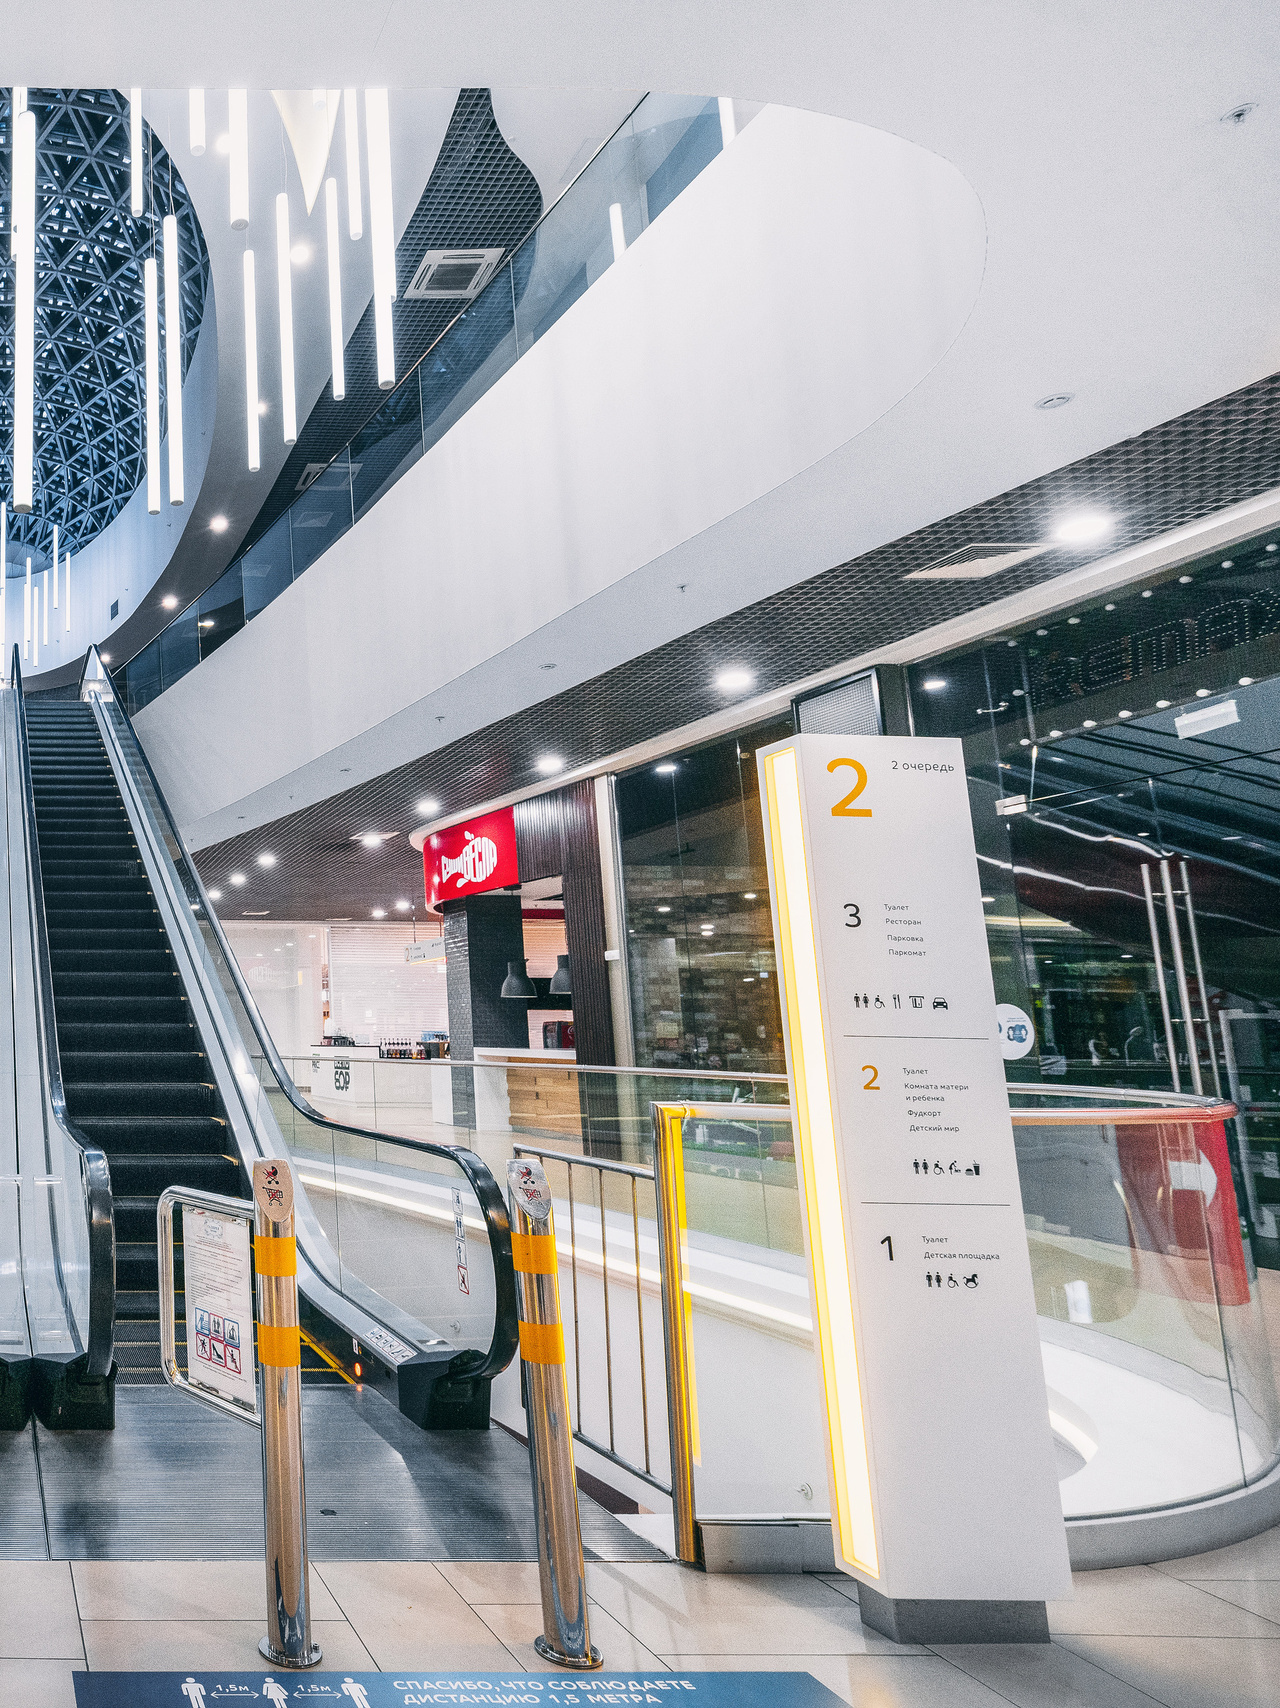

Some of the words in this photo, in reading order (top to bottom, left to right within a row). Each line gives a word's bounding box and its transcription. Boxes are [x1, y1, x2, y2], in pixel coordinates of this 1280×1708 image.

[891, 760, 899, 771] 2
[902, 761, 955, 773] очередь
[826, 757, 873, 818] 2
[883, 903, 909, 912] Туалет
[843, 903, 862, 928] 3
[885, 917, 922, 927] Ресторан
[887, 934, 924, 943] Парковка
[888, 948, 927, 957] Паркомат
[902, 1067, 928, 1076] Туалет
[861, 1064, 881, 1090] 2
[940, 1084, 969, 1092] матери
[907, 1109, 942, 1118] Фудкорт
[909, 1124, 943, 1133] Детский
[921, 1235, 949, 1245] Туалет
[879, 1235, 895, 1262] 1
[923, 1251, 957, 1260] Детская
[958, 1252, 1000, 1261] площадка
[500, 1680, 544, 1691] ЧТО
[548, 1680, 696, 1692] СОБЛЮДАЕТЕ
[403, 1694, 541, 1706] ДИСТАНЦИЮ
[548, 1694, 580, 1706] 1,5
[587, 1694, 662, 1705] МЕТРА
